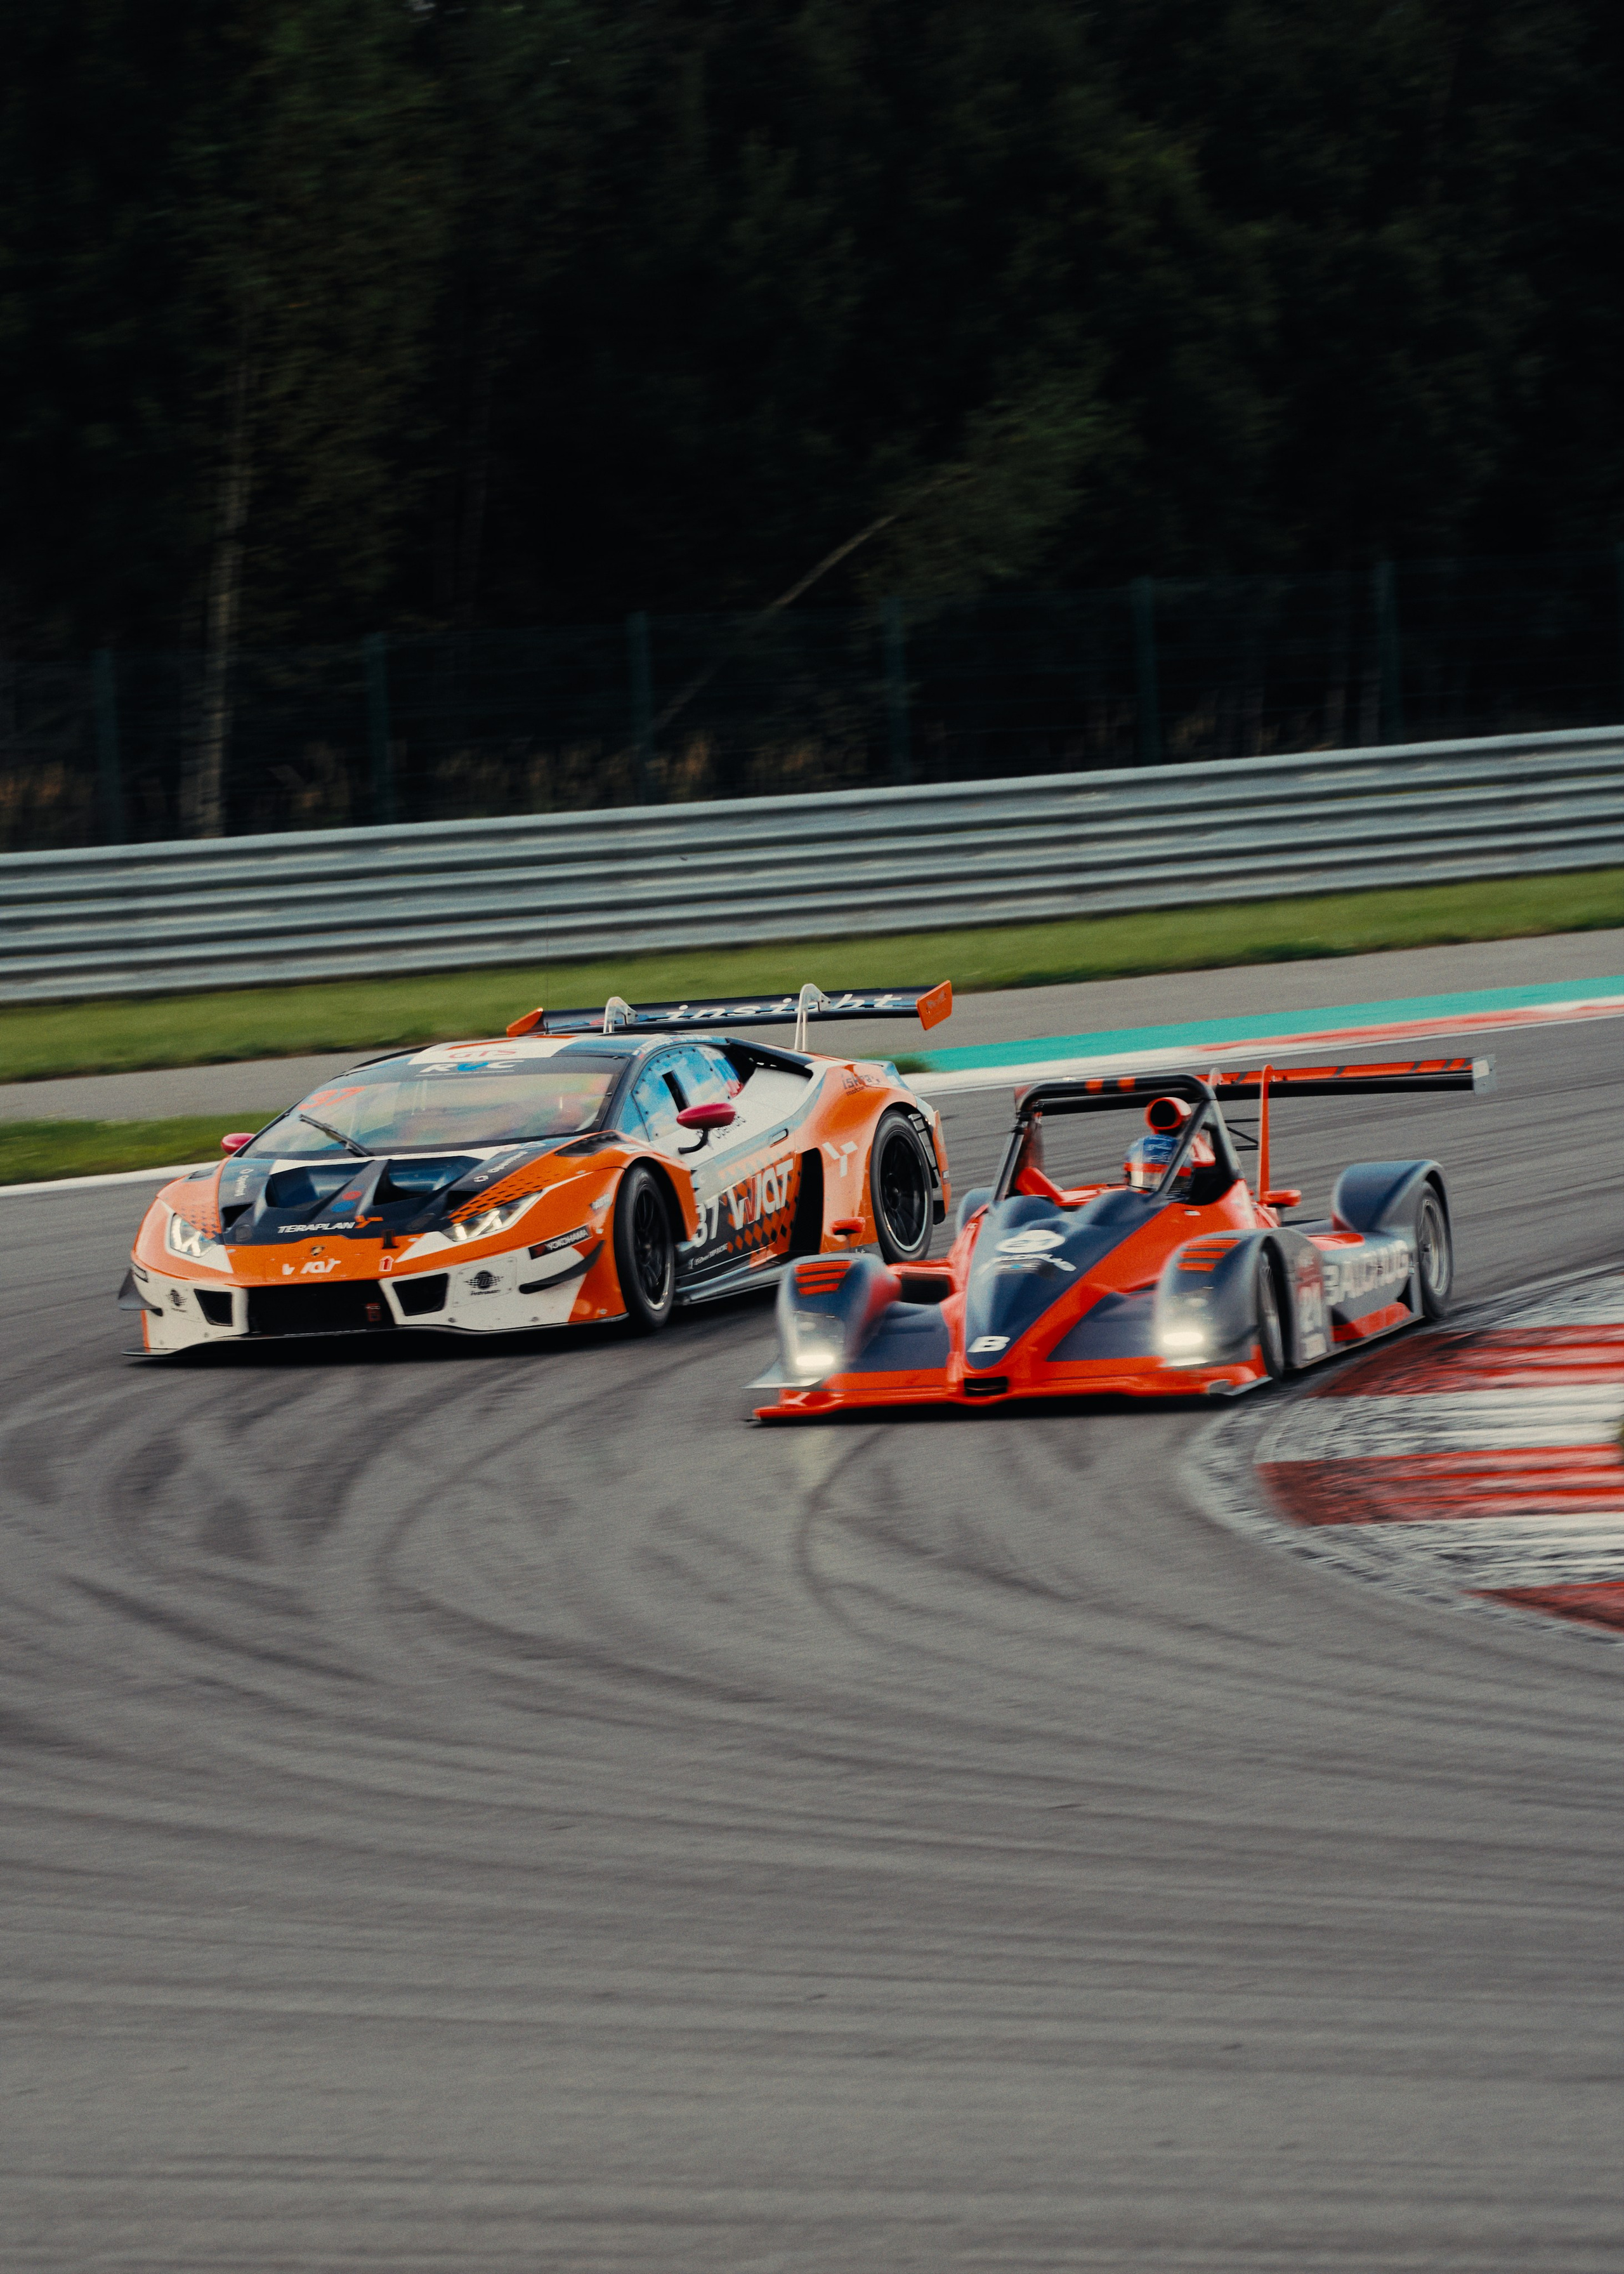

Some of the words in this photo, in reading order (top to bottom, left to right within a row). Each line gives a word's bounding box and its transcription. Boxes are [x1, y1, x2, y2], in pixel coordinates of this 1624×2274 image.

[298, 1086, 366, 1110] 37
[277, 1221, 355, 1233] TERAPLAN
[693, 1195, 720, 1247] 37
[545, 1229, 589, 1251] YOKOHAMA
[967, 1336, 1011, 1353] B
